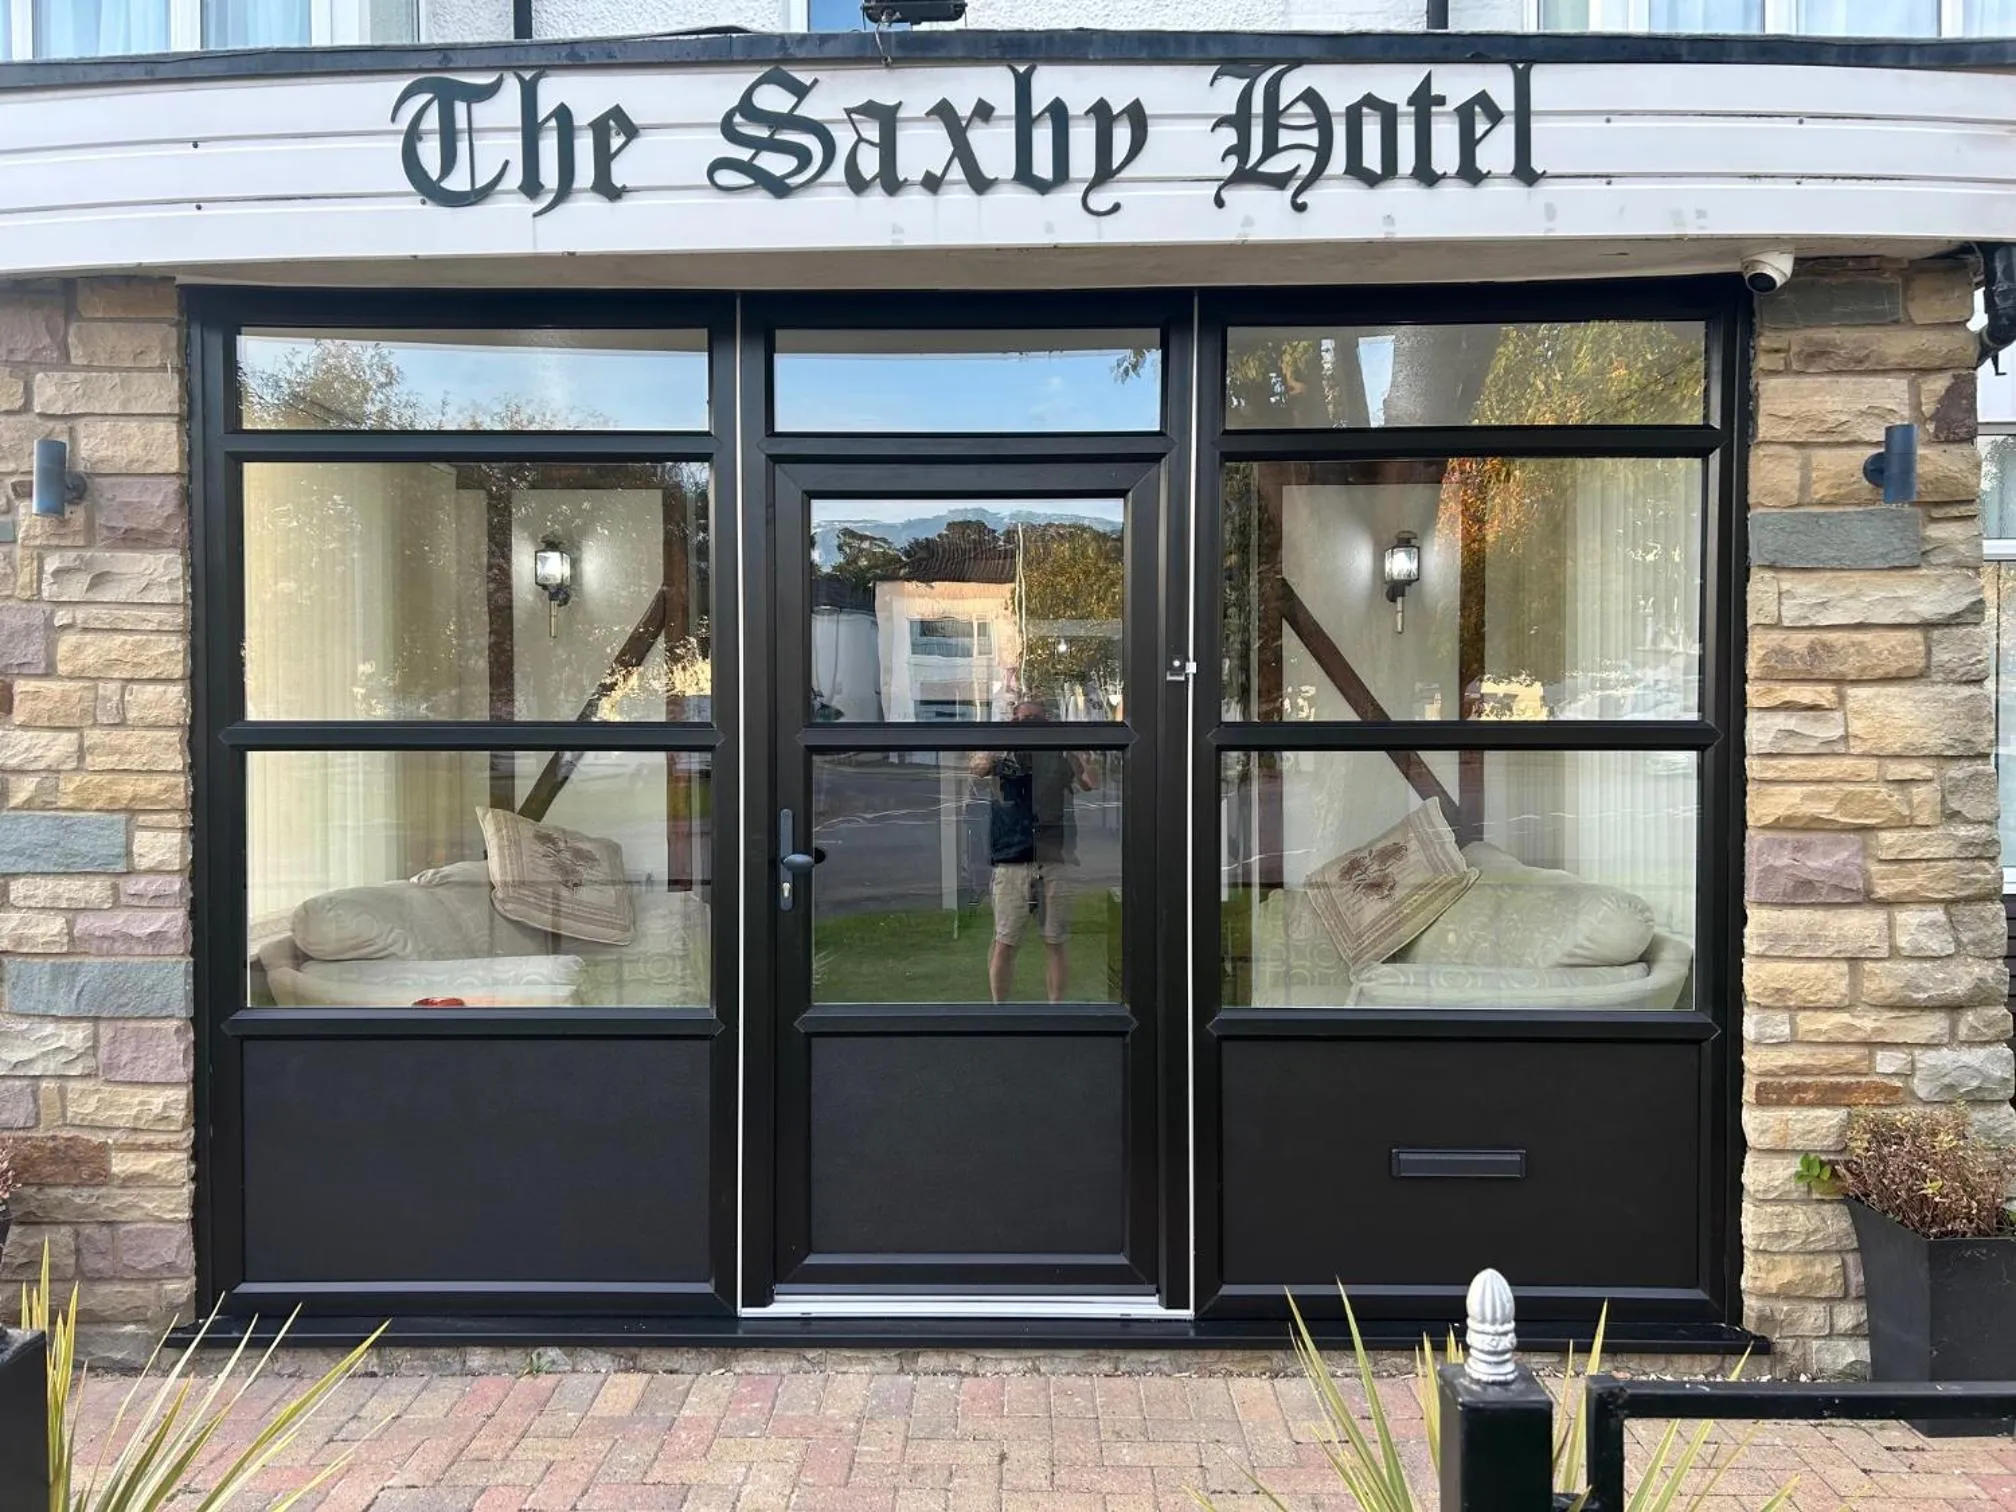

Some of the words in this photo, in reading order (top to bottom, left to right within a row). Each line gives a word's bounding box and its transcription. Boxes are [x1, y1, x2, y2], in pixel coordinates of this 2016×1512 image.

[391, 69, 639, 217] The
[707, 64, 1148, 216] Saxby
[1210, 62, 1546, 211] Hotel
